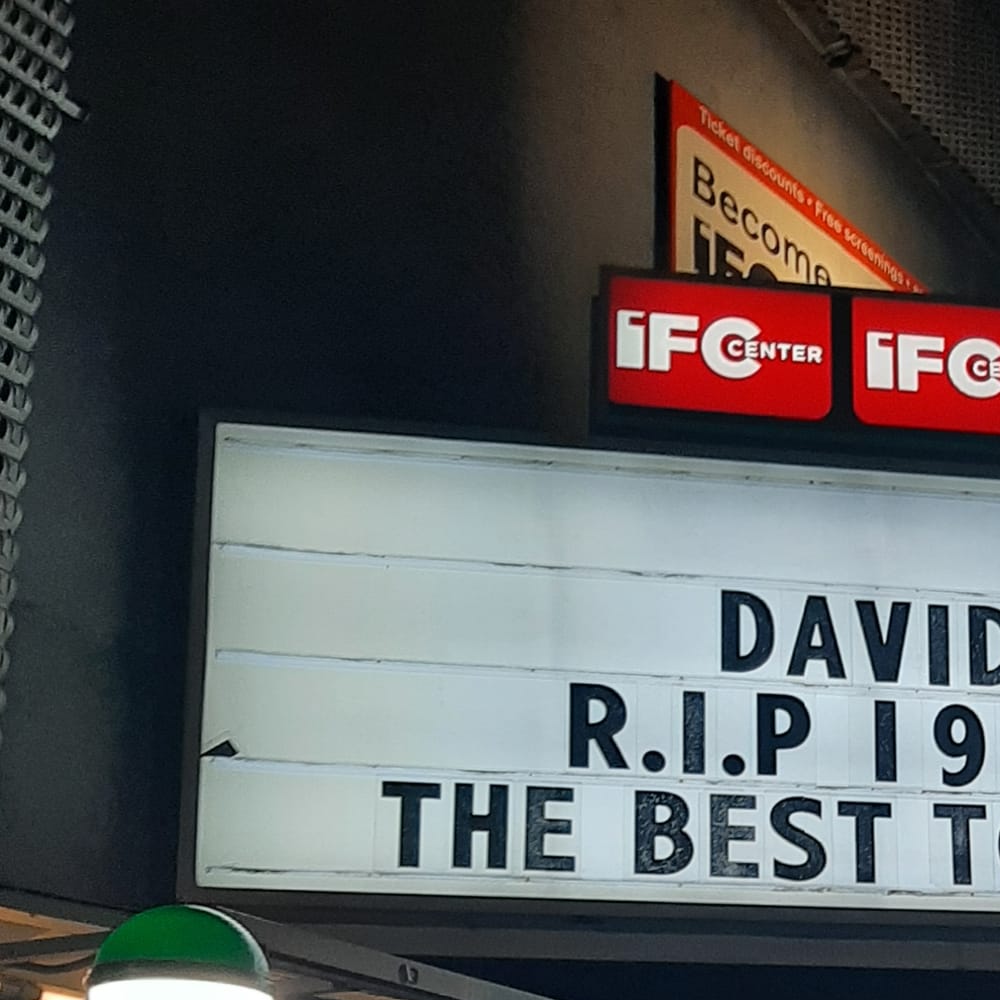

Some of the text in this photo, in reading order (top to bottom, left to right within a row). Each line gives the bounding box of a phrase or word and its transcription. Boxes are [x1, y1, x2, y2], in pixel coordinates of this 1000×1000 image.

[693, 156, 832, 286] Become
[699, 103, 905, 286] Ticket discounts Free screenings
[727, 339, 823, 364] CENTER
[568, 682, 811, 776] R.I.P
[381, 781, 576, 873] THE
[634, 790, 892, 885] BEST
